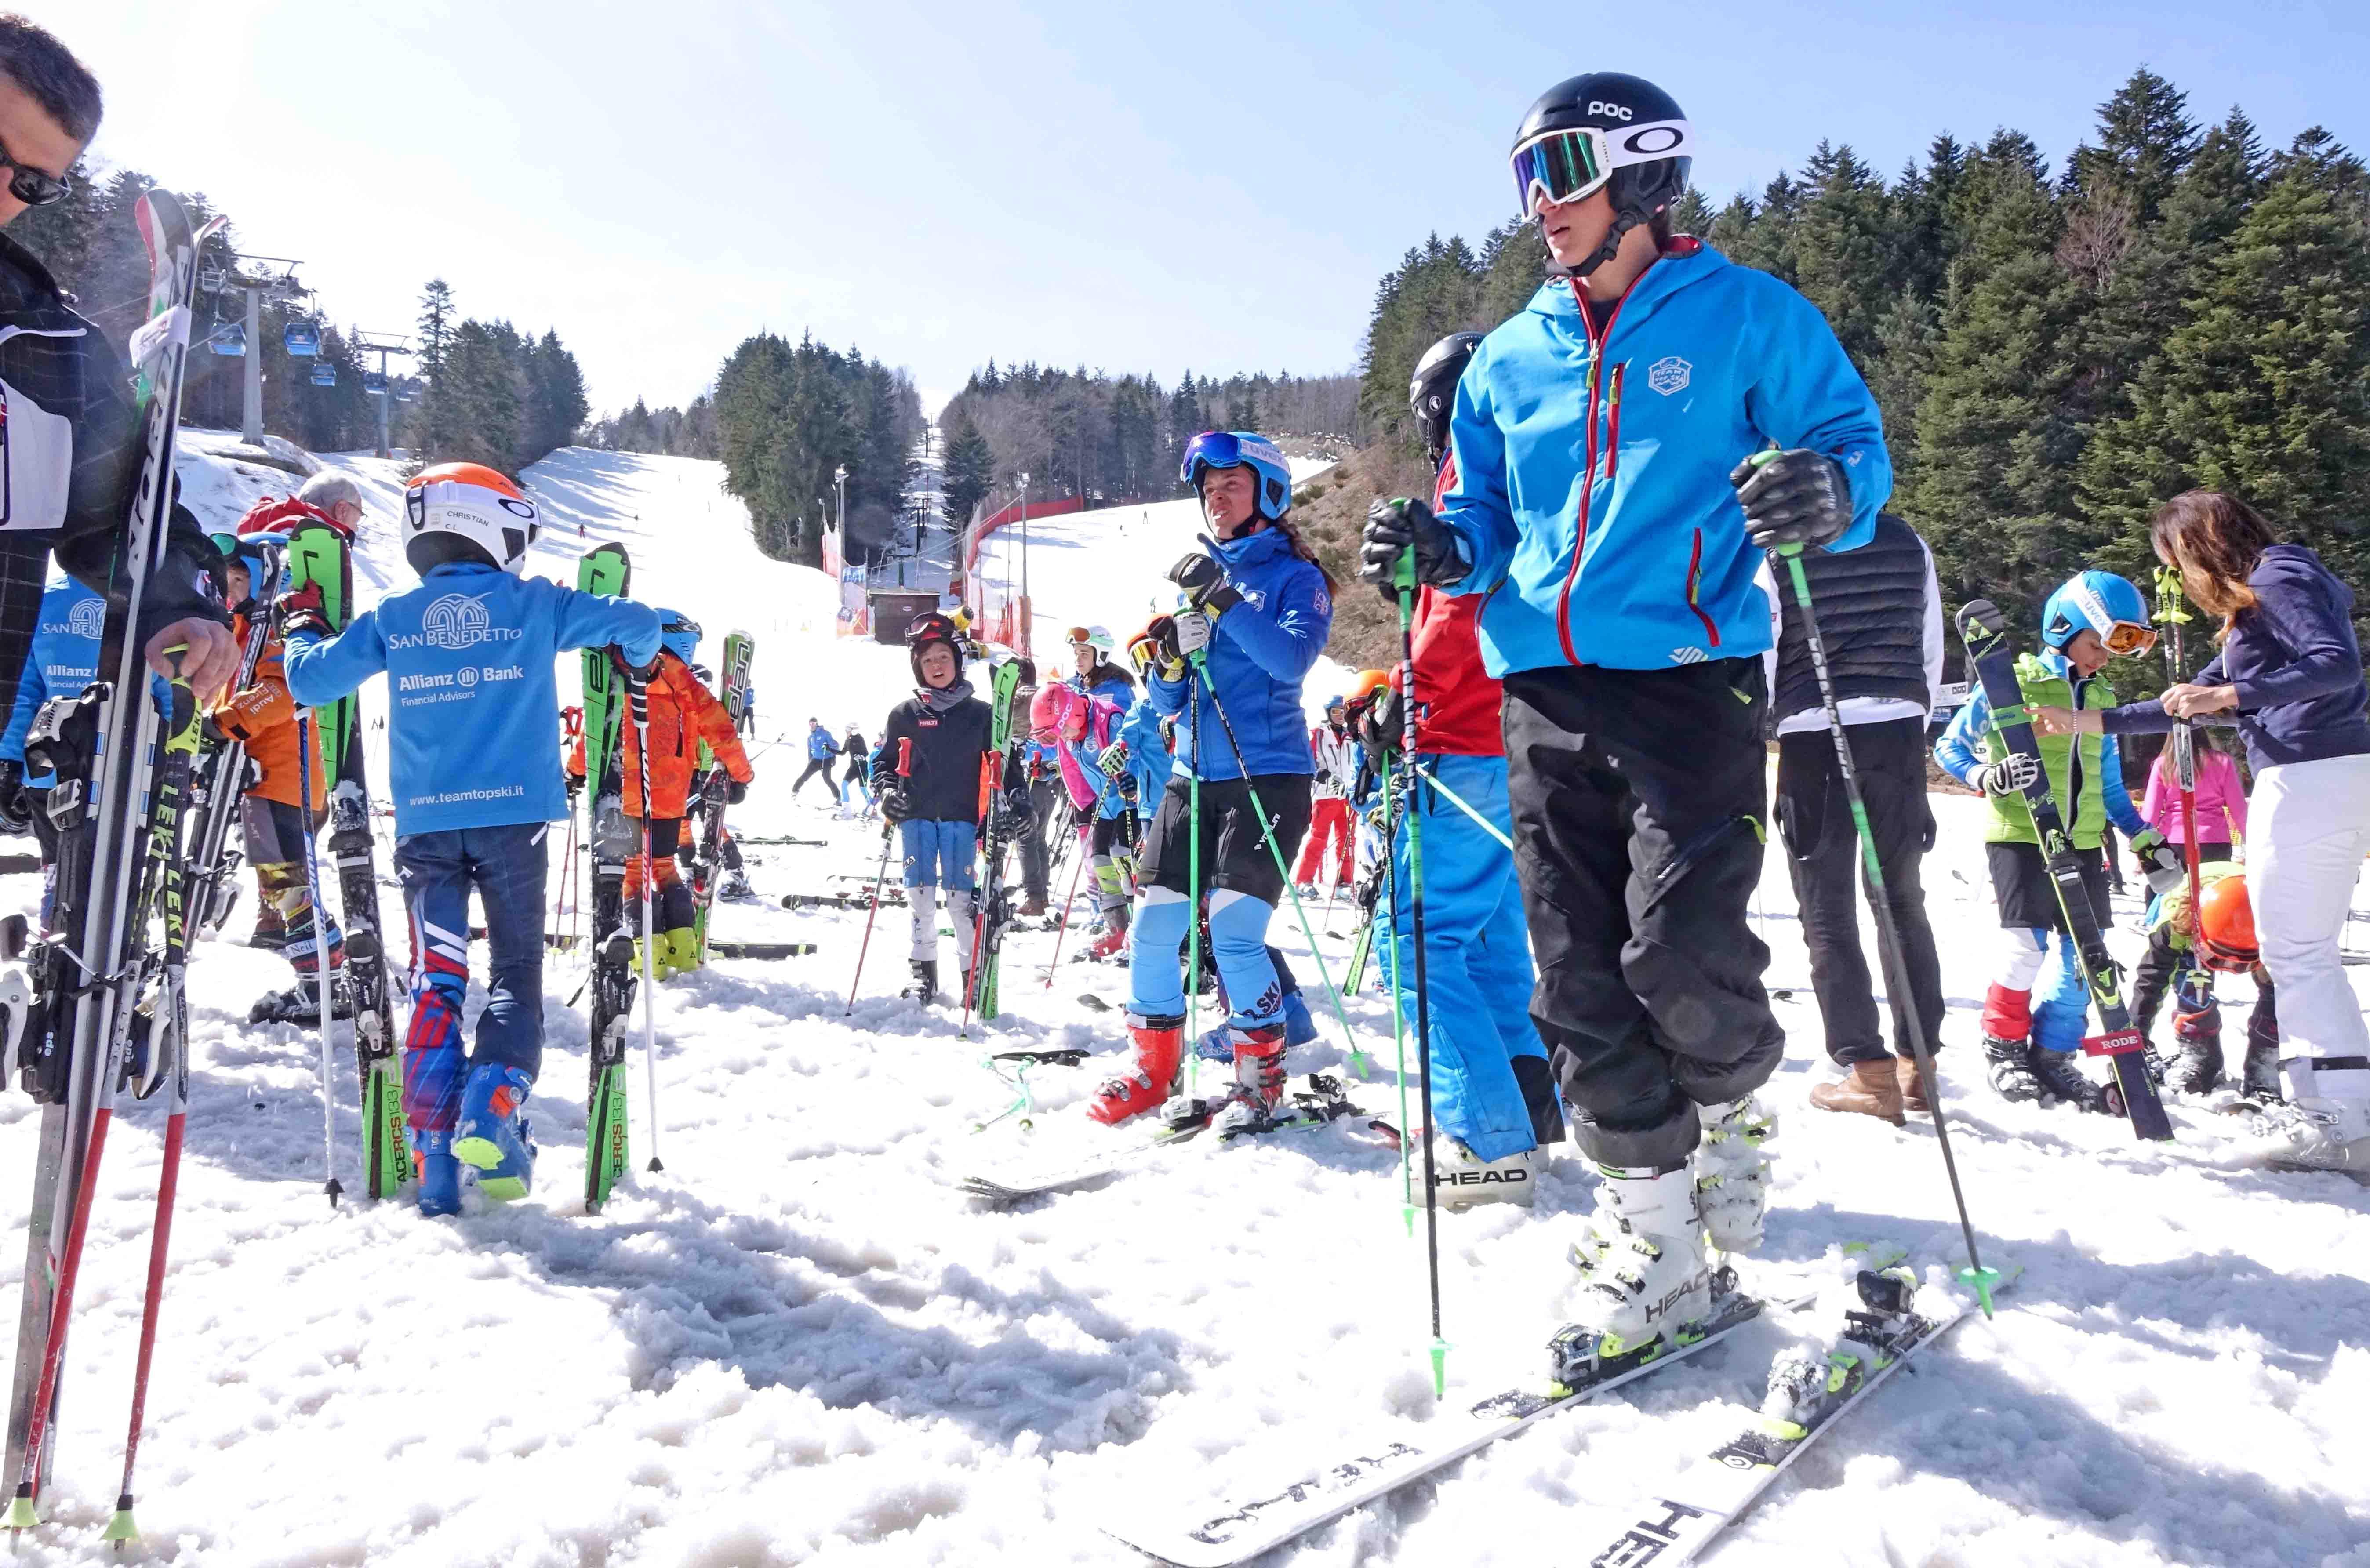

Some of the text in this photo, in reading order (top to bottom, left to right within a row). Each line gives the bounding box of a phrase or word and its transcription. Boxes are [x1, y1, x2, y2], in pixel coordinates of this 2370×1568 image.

[447, 511, 489, 527] CHRISTIAN
[47, 664, 92, 677] Allianz
[400, 665, 524, 691] Allianz Bank
[401, 690, 475, 707] Financial Advisors
[189, 710, 201, 744] LEKI
[410, 785, 524, 806] www.teamtopski.it
[167, 868, 183, 947] LEKI
[1256, 980, 1280, 1013] SKI
[2101, 1035, 2138, 1049] RODE
[1435, 1169, 1527, 1187] HEAD
[1590, 1499, 1705, 1568] HE
